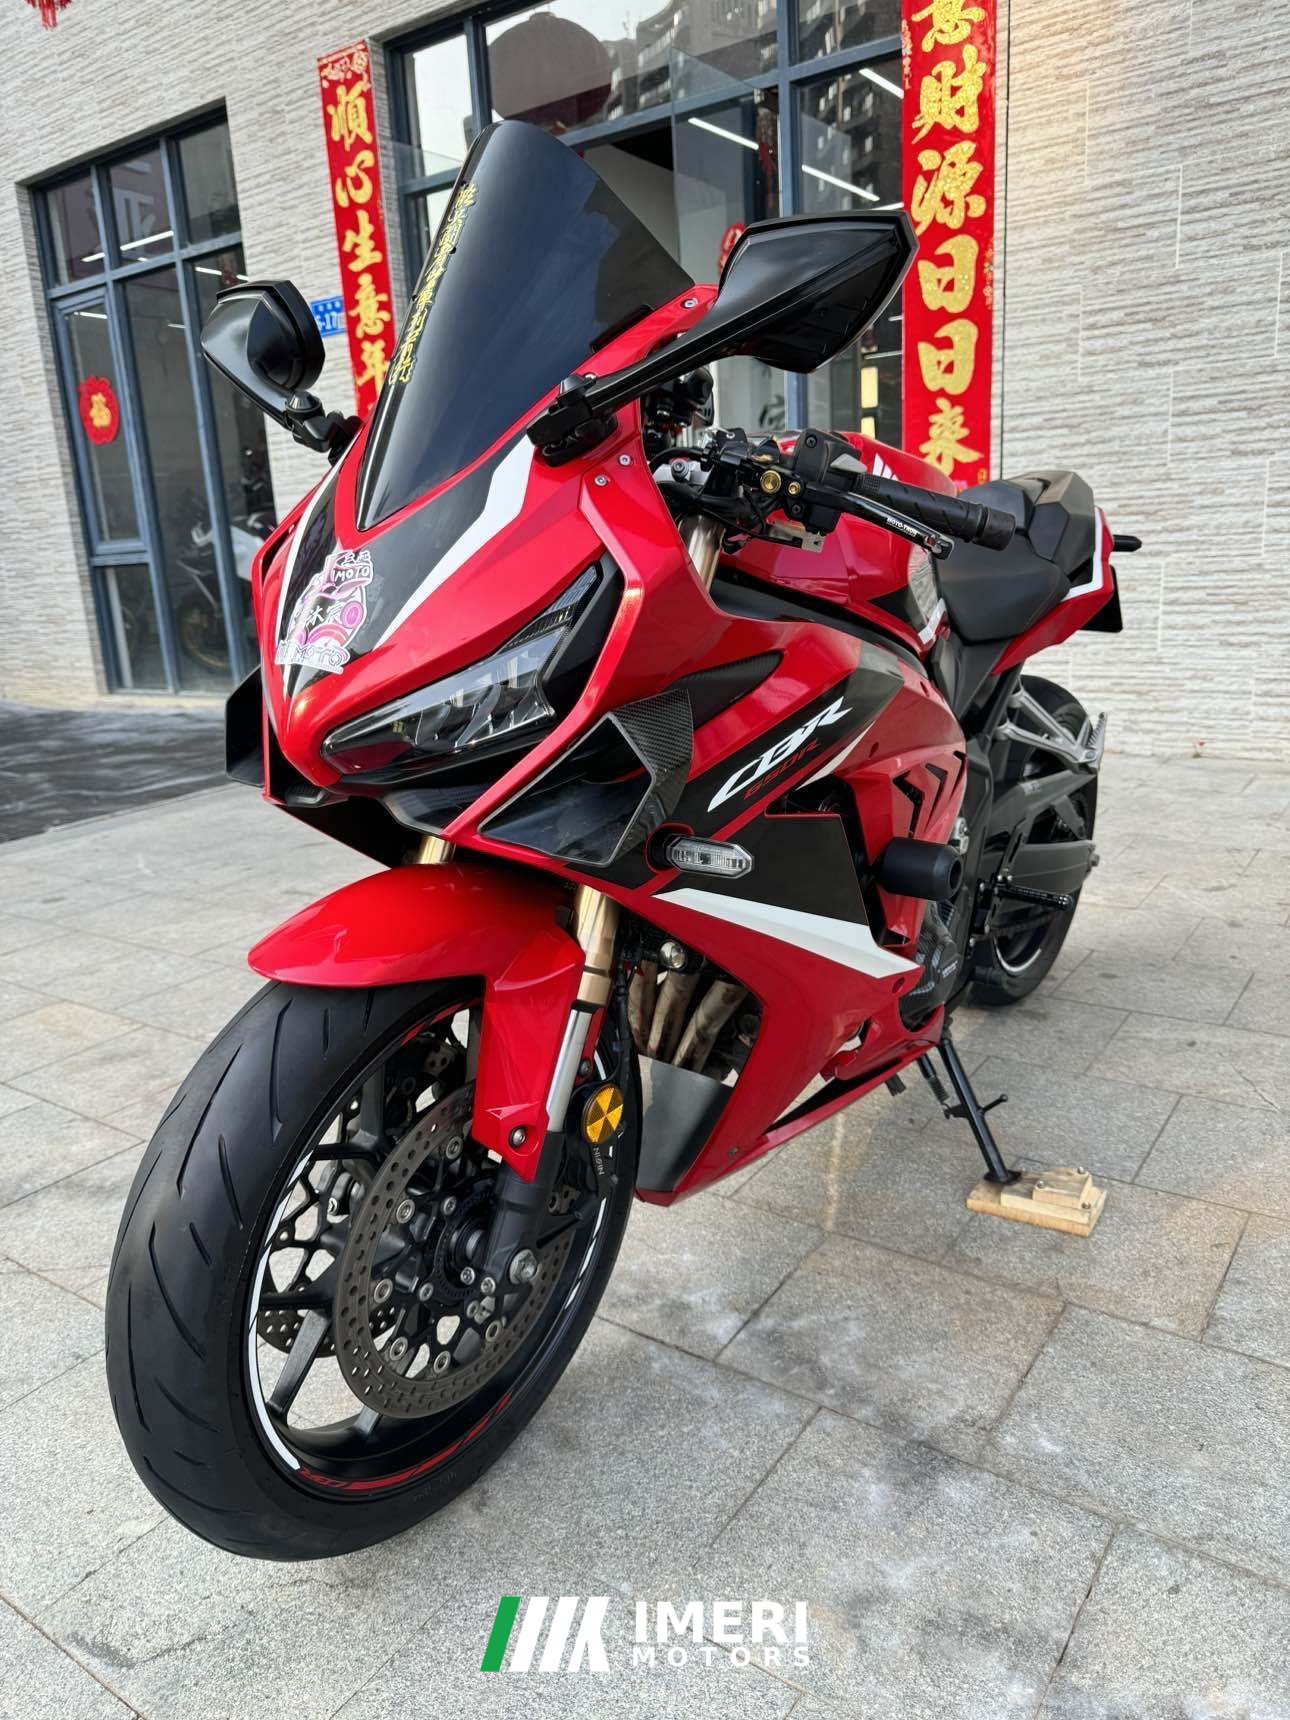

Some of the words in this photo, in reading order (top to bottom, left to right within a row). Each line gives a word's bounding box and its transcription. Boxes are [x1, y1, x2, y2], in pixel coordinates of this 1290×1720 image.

[326, 80, 391, 411] 順心生意年
[335, 565, 370, 582] MOTO
[707, 696, 853, 813] CBR
